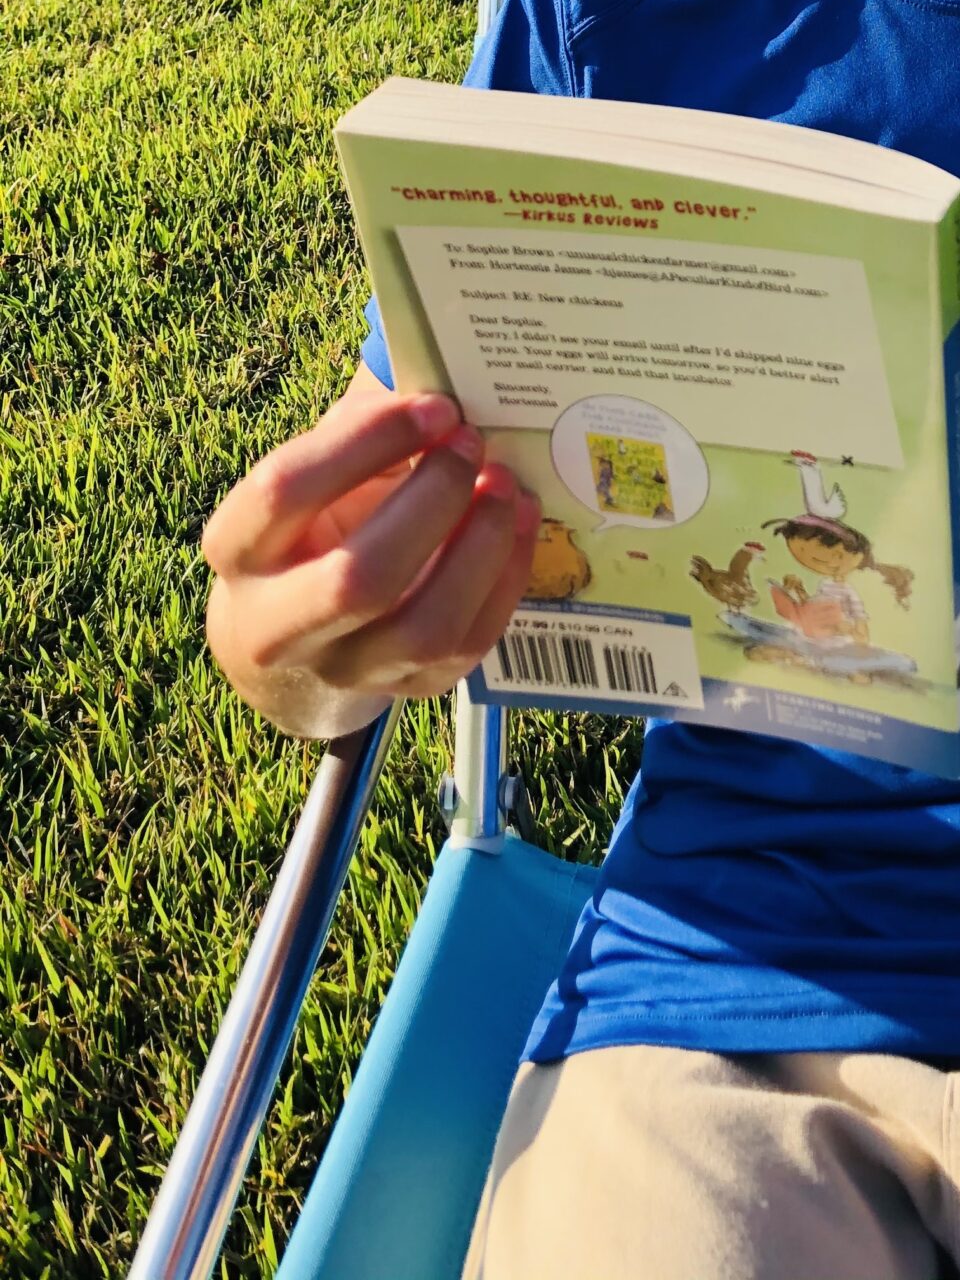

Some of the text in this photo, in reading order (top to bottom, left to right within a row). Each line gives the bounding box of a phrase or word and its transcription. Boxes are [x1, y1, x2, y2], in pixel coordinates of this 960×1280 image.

[583, 212, 659, 229] Reviews
[539, 293, 565, 304] New
[582, 337, 609, 348] your
[683, 345, 712, 356] after
[735, 349, 783, 364] shipped
[817, 361, 846, 372] eggs
[587, 350, 609, 361] will
[769, 367, 806, 381] better
[810, 373, 840, 386] alert
